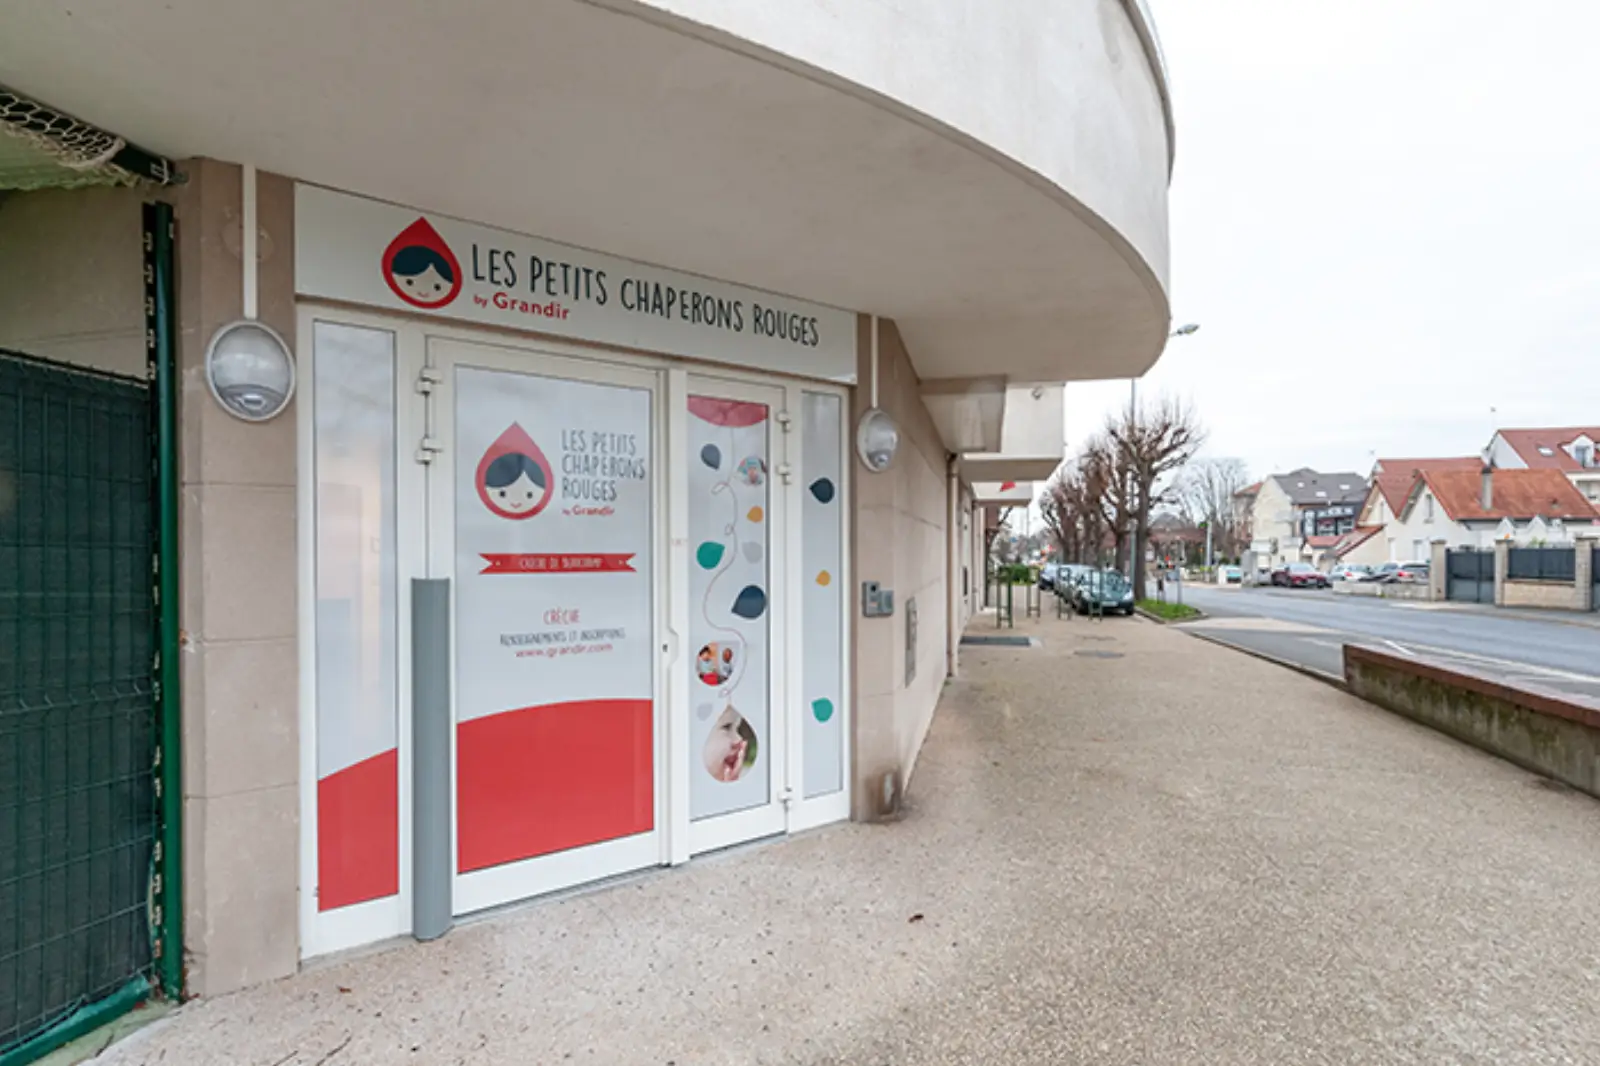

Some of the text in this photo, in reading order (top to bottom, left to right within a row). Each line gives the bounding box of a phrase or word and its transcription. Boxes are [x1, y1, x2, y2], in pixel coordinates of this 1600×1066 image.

[472, 243, 819, 348] LES PETITS CHAPERONS ROUGES
[473, 291, 570, 320] by Grandir
[562, 429, 637, 456] LES PETITS
[562, 453, 646, 481] CHAPERONS
[562, 476, 617, 502] ROUGES
